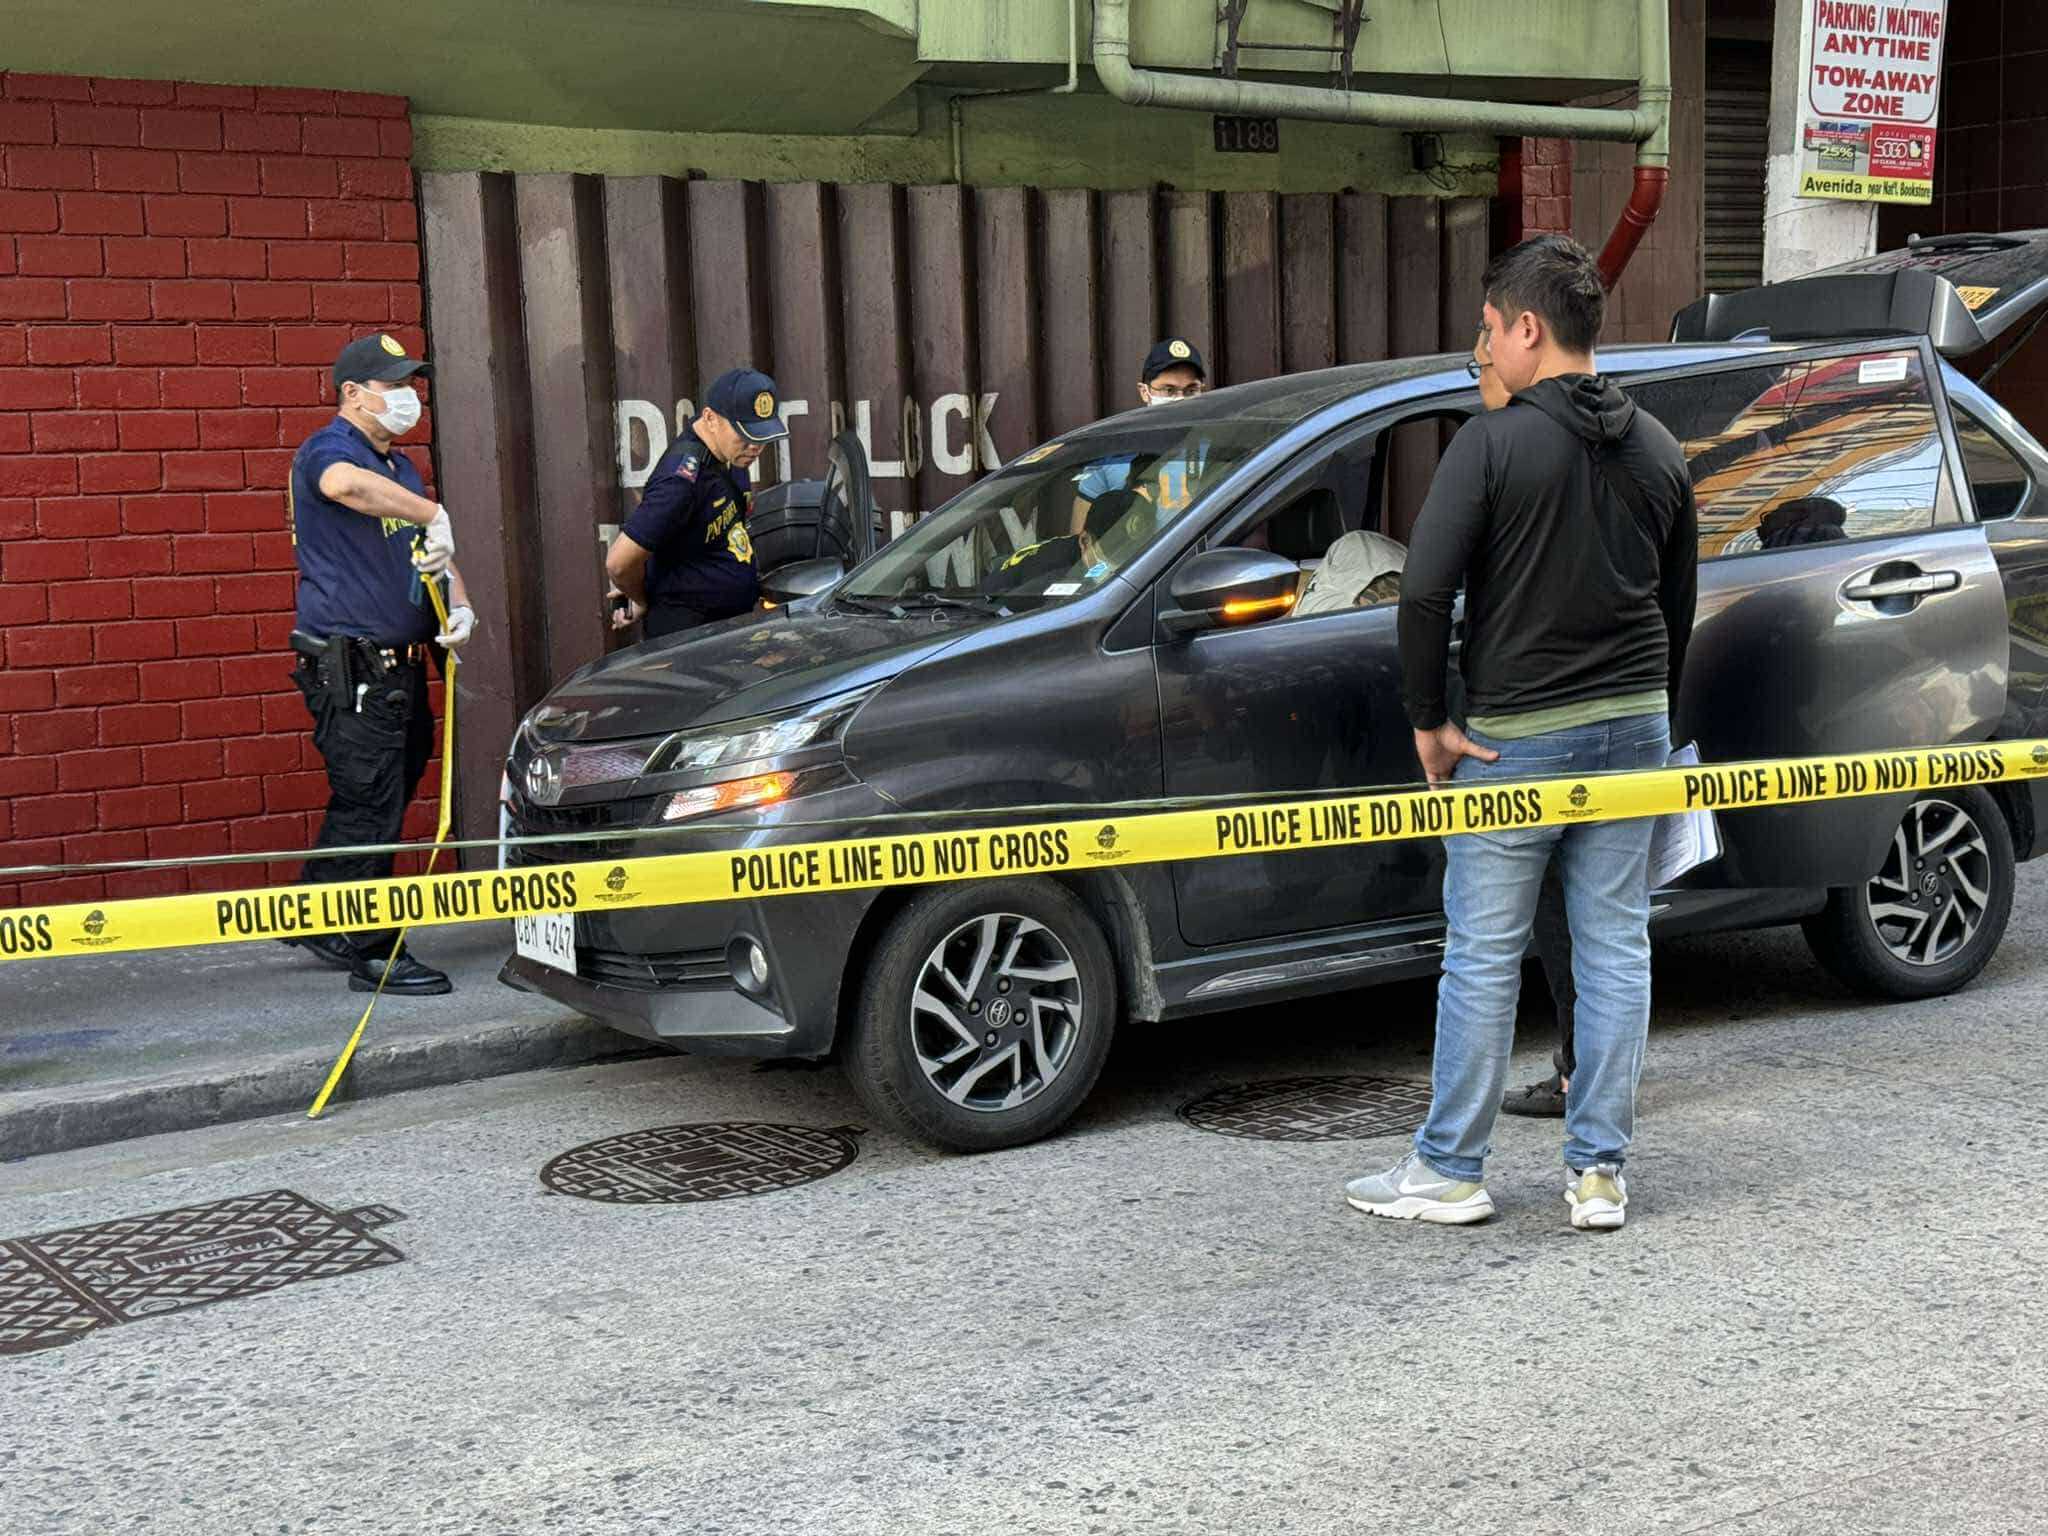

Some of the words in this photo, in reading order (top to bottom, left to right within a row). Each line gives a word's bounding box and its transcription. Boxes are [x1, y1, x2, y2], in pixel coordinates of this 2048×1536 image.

[1819, 1, 1876, 33] PARKING
[1887, 7, 1940, 39] WAITING
[1824, 33, 1931, 62] ANYTIME
[1815, 65, 1936, 94] TOW-AWAY
[1843, 93, 1905, 116] ZONE
[1217, 120, 1276, 150] 1188
[1820, 145, 1854, 158] 25%
[1804, 176, 1862, 194] Avenida
[1684, 768, 1768, 808] POLICE
[1776, 764, 1827, 800] LINE
[1835, 761, 1867, 794] DO
[1874, 757, 1918, 790] NOT
[1927, 749, 2005, 785] CROSS
[1216, 808, 1301, 850] POLICE
[1309, 803, 1362, 842] LINE
[1369, 799, 1402, 838] DO
[1410, 795, 1458, 834] NOT
[1463, 788, 1542, 829] CROSS
[731, 850, 821, 893] POLICE
[829, 844, 883, 884] LINE
[891, 841, 925, 880] DO
[933, 836, 981, 875] NOT
[989, 828, 1070, 870] CROSS
[217, 893, 313, 936] POLICE
[321, 887, 380, 927] LINE
[388, 883, 424, 922] DO
[430, 878, 483, 918] NOT
[492, 870, 577, 913] CROSS
